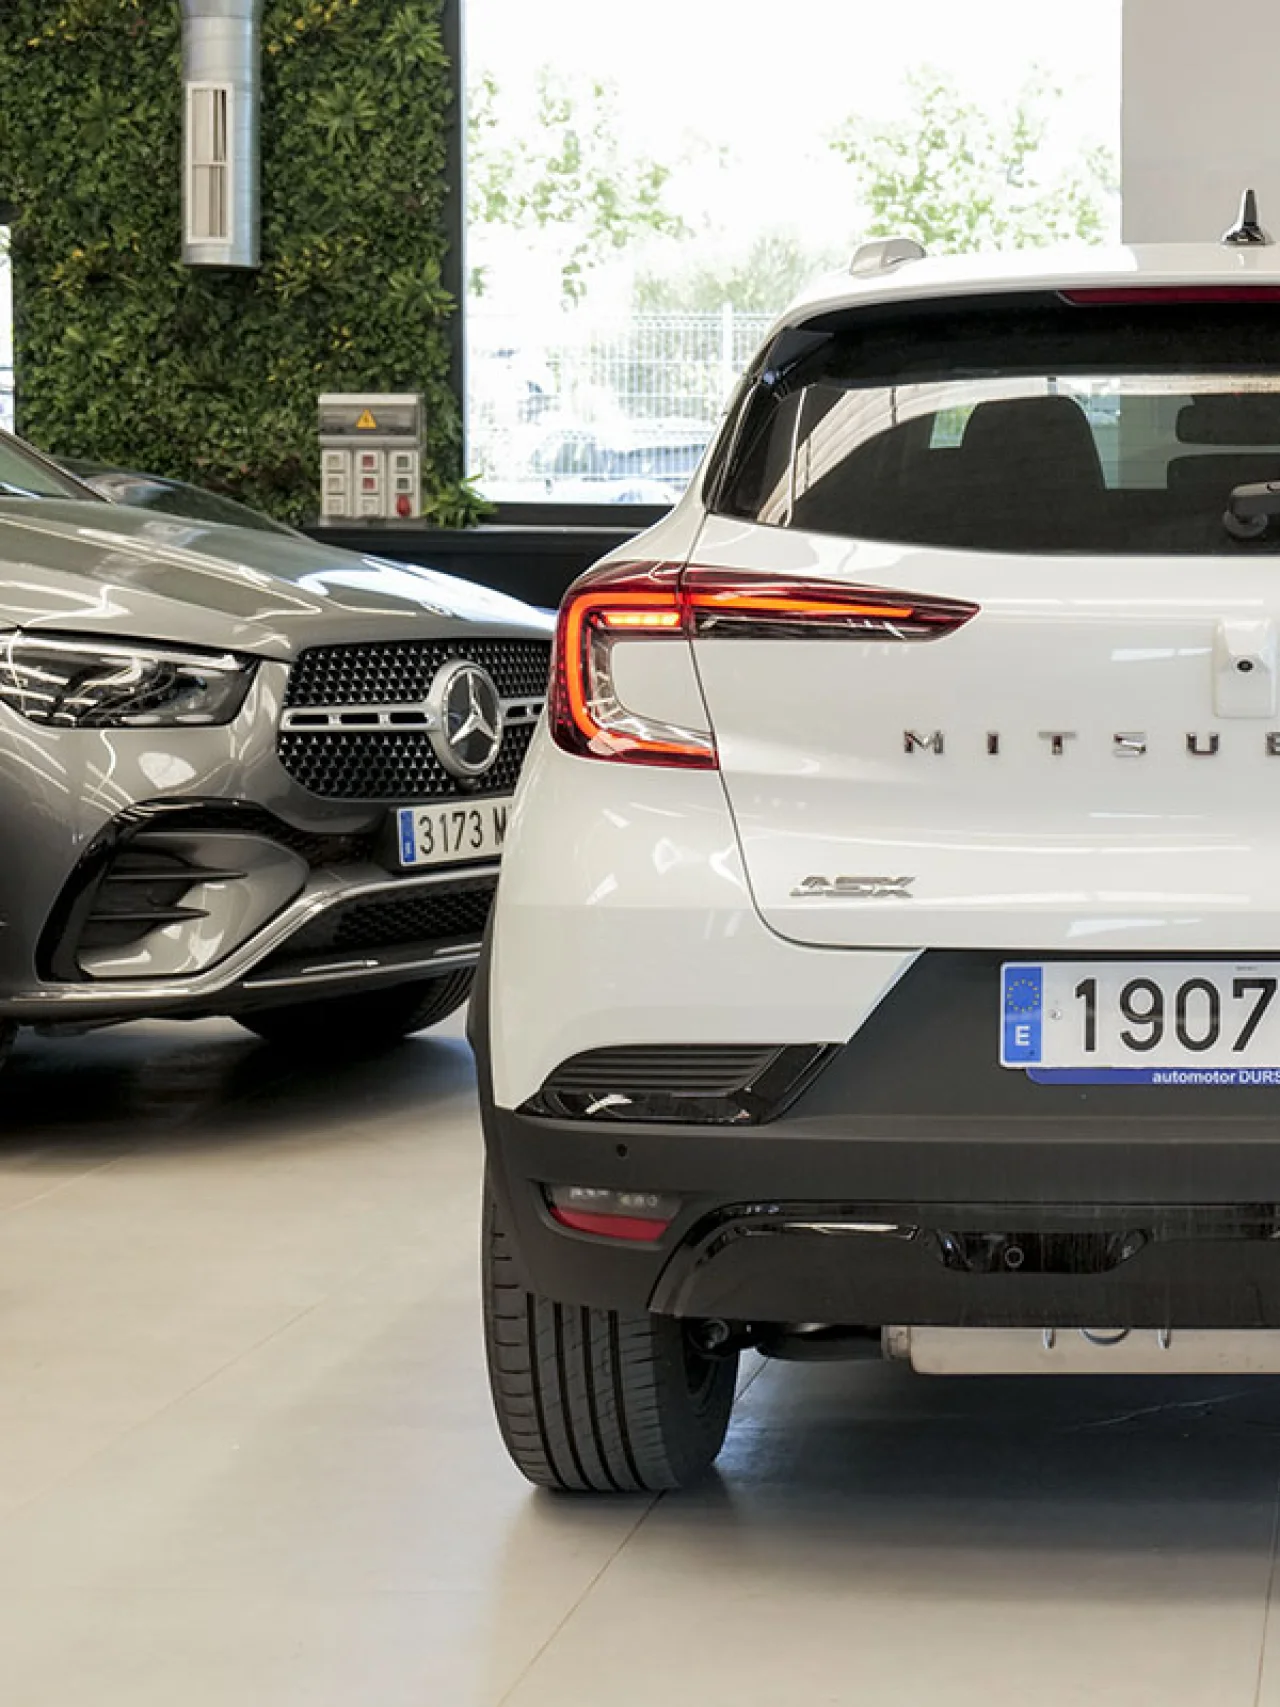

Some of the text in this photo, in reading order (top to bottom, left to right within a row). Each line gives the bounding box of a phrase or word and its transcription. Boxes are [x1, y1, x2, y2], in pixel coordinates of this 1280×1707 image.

[419, 810, 482, 854] 3173
[789, 876, 916, 898] ASX
[1074, 977, 1279, 1053] 1907
[1015, 1026, 1031, 1047] E
[1152, 1070, 1236, 1084] automotor
